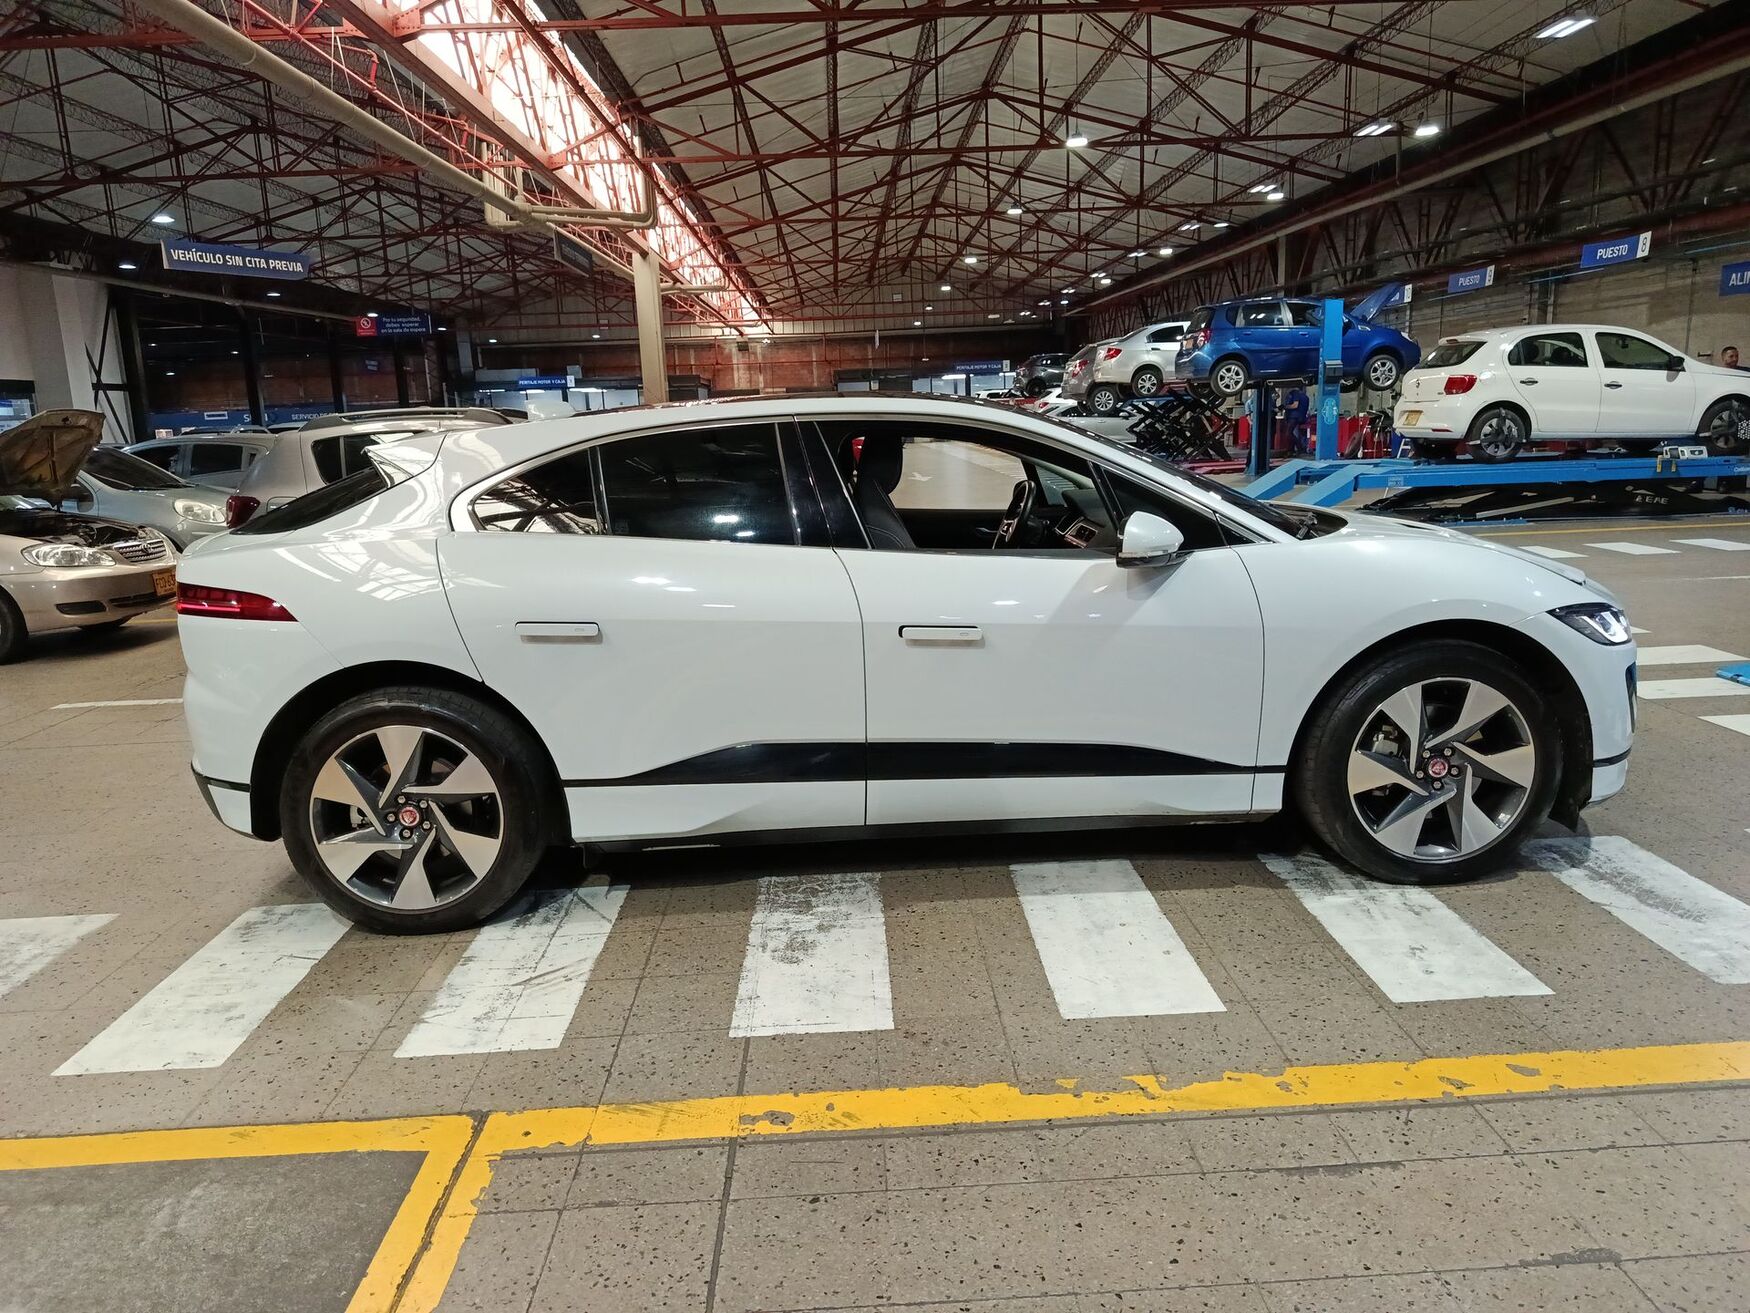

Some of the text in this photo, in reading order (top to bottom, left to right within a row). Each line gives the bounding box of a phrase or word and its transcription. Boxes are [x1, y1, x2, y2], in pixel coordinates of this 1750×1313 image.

[1596, 236, 1648, 260] PUESTO 8
[170, 248, 304, 273] VEHÍCULO SIN CITA PREVIA
[1458, 269, 1493, 287] PUESTO 9
